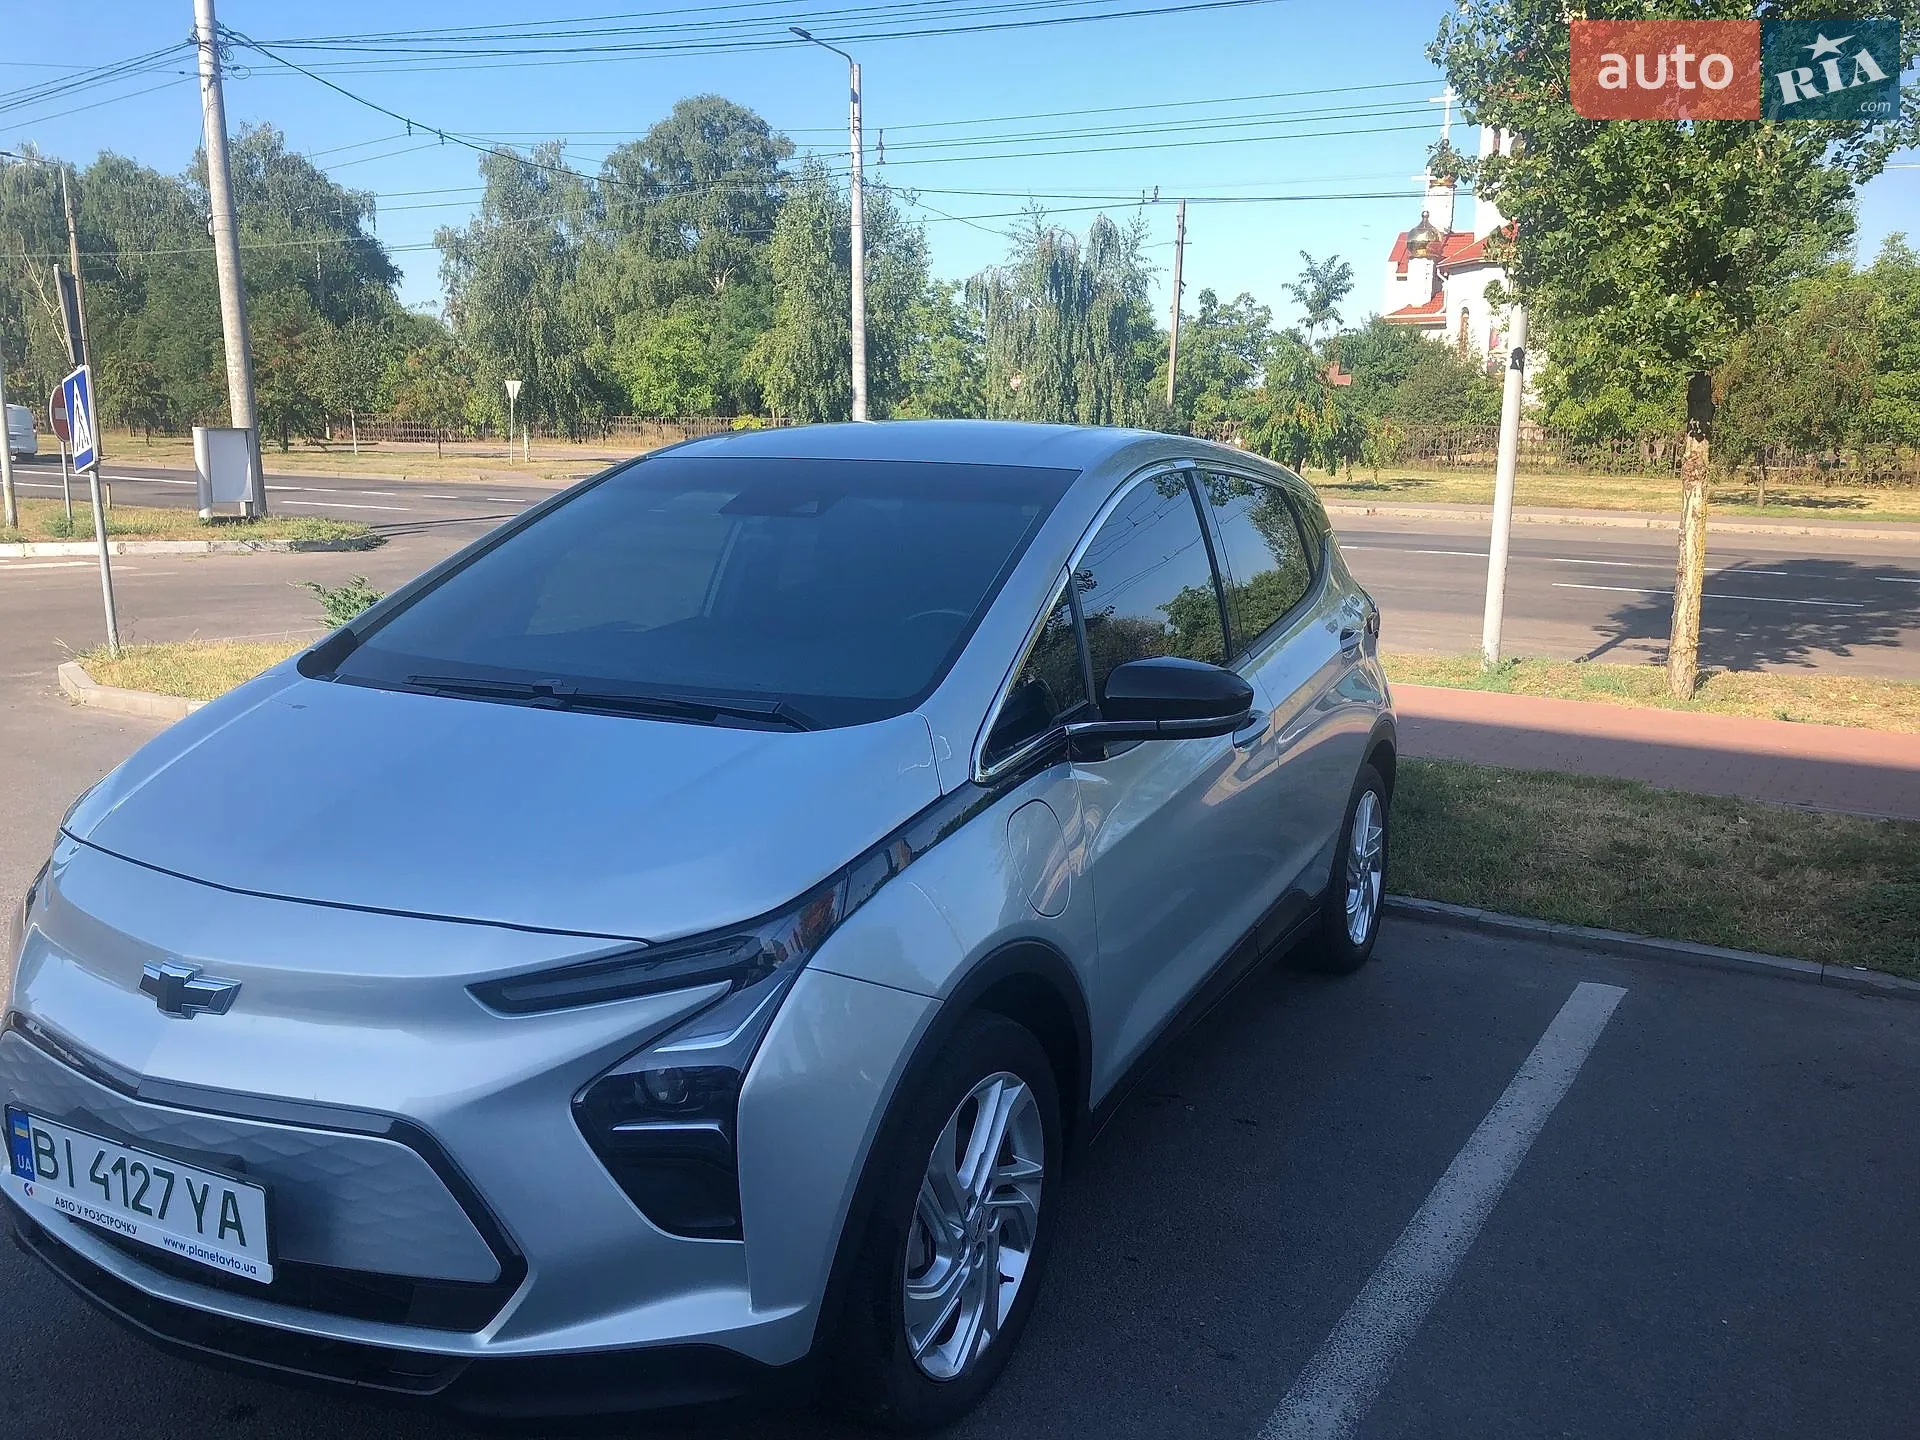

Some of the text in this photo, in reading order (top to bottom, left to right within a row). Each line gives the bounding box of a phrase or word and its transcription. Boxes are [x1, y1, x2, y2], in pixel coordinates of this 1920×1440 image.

[16, 1154, 33, 1174] UA
[32, 1127, 247, 1247] BI 4127 YA
[54, 1195, 76, 1212] АВТО
[84, 1206, 138, 1235] РОЗСТРОЧКУ
[162, 1235, 257, 1275] www.planetavto.ua
